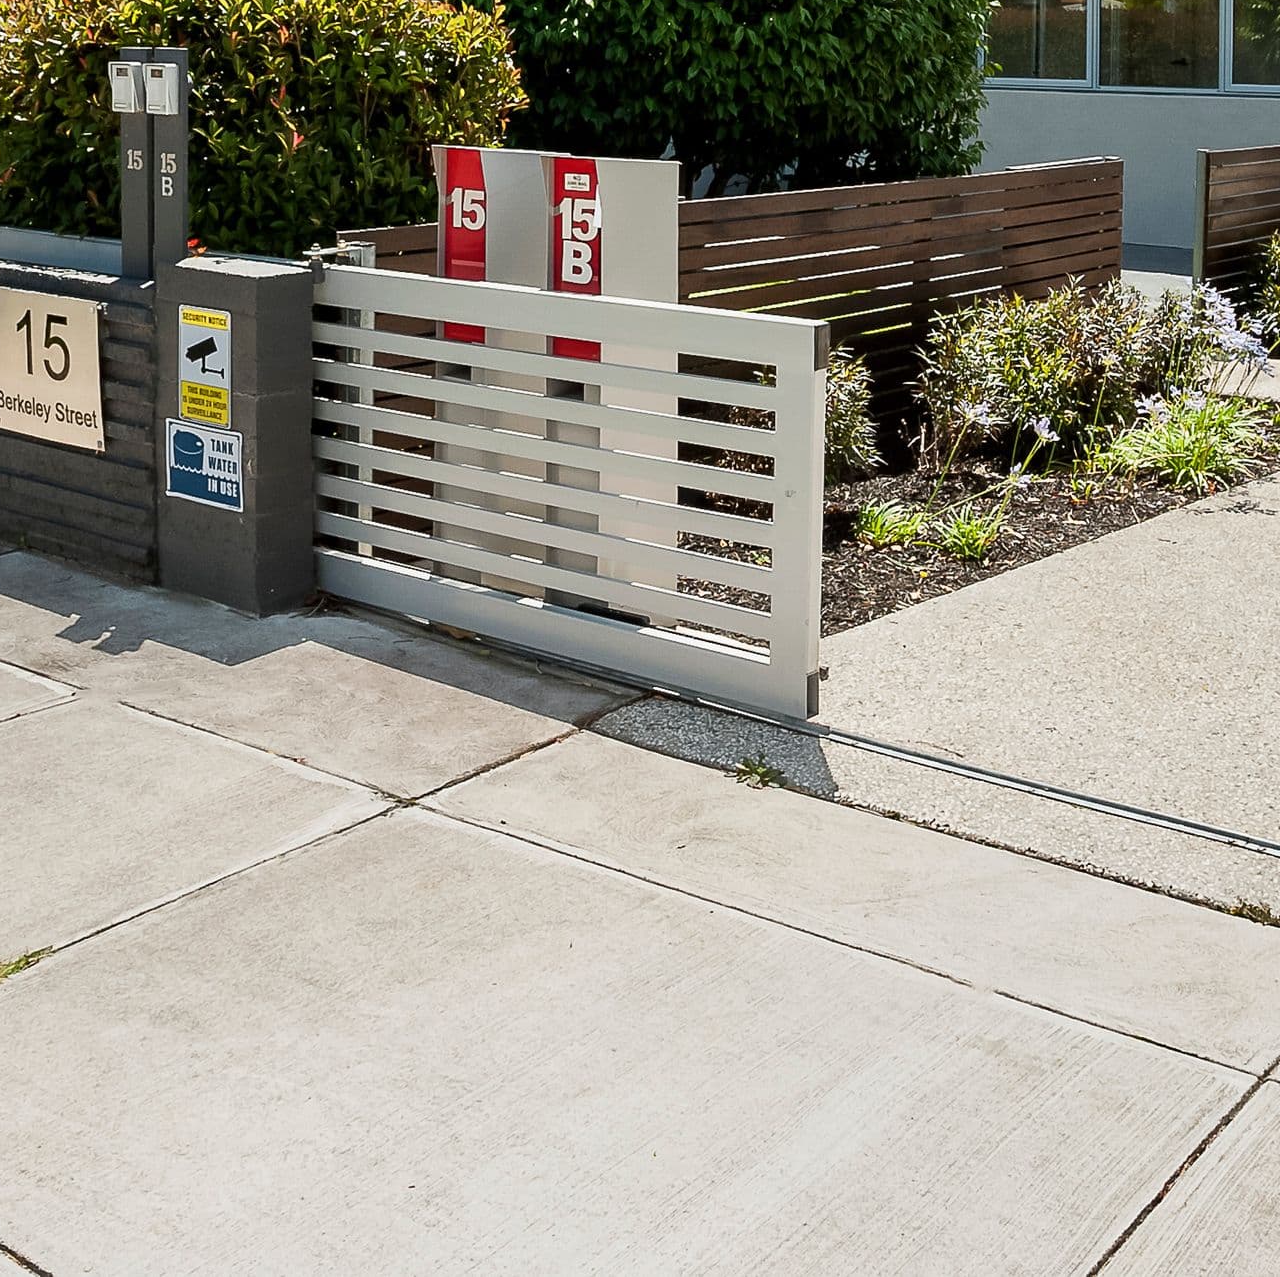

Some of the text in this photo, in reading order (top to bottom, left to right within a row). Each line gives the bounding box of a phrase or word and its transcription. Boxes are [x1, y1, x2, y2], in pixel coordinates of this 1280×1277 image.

[127, 149, 144, 170] 15
[160, 152, 177, 174] 15
[162, 176, 174, 197] B
[451, 187, 486, 231] 15
[559, 197, 598, 241] 15
[562, 240, 593, 284] B
[182, 312, 227, 326] SECURITY NOTICE
[16, 309, 70, 381] 15
[55, 402, 98, 428] Street
[187, 406, 222, 420] SURVEILLANCE
[210, 439, 234, 455] TANK
[208, 456, 237, 474] WATER
[208, 478, 238, 498] IN USE
